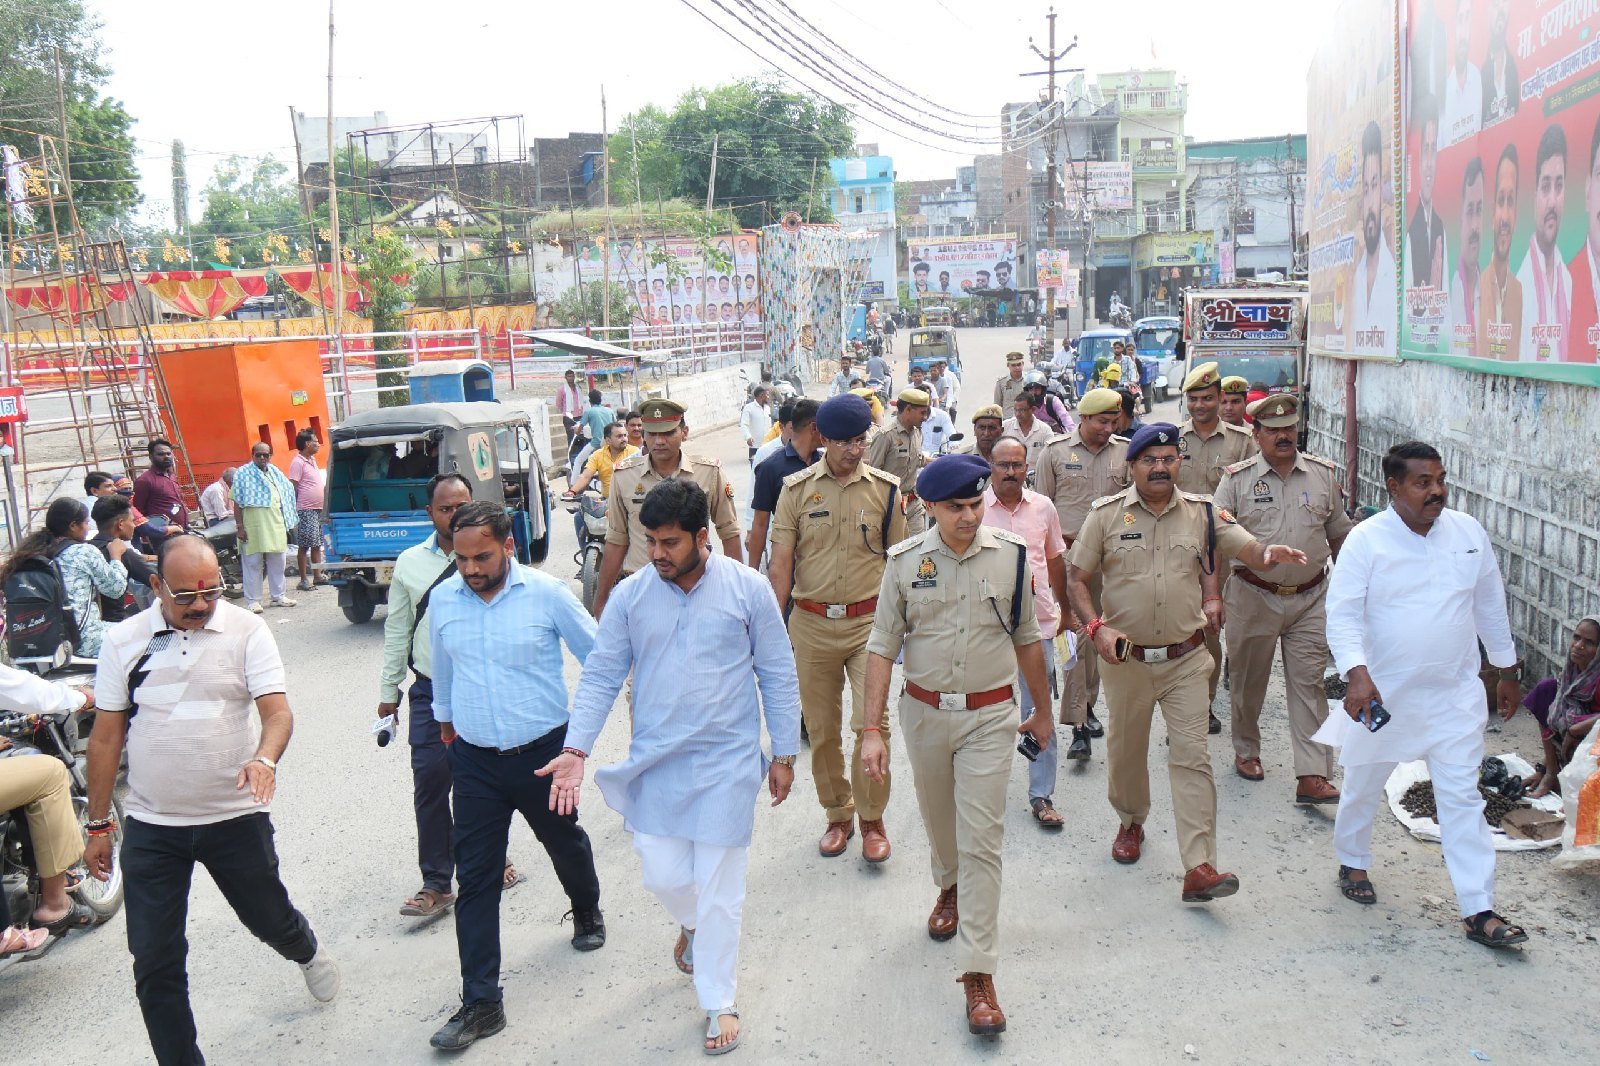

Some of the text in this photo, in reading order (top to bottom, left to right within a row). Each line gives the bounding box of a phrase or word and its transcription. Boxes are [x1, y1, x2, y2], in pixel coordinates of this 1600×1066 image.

[1517, 25, 1537, 60] मा.
[1203, 299, 1292, 322] श्रीनाथ
[364, 529, 408, 538] PIAGGIO
